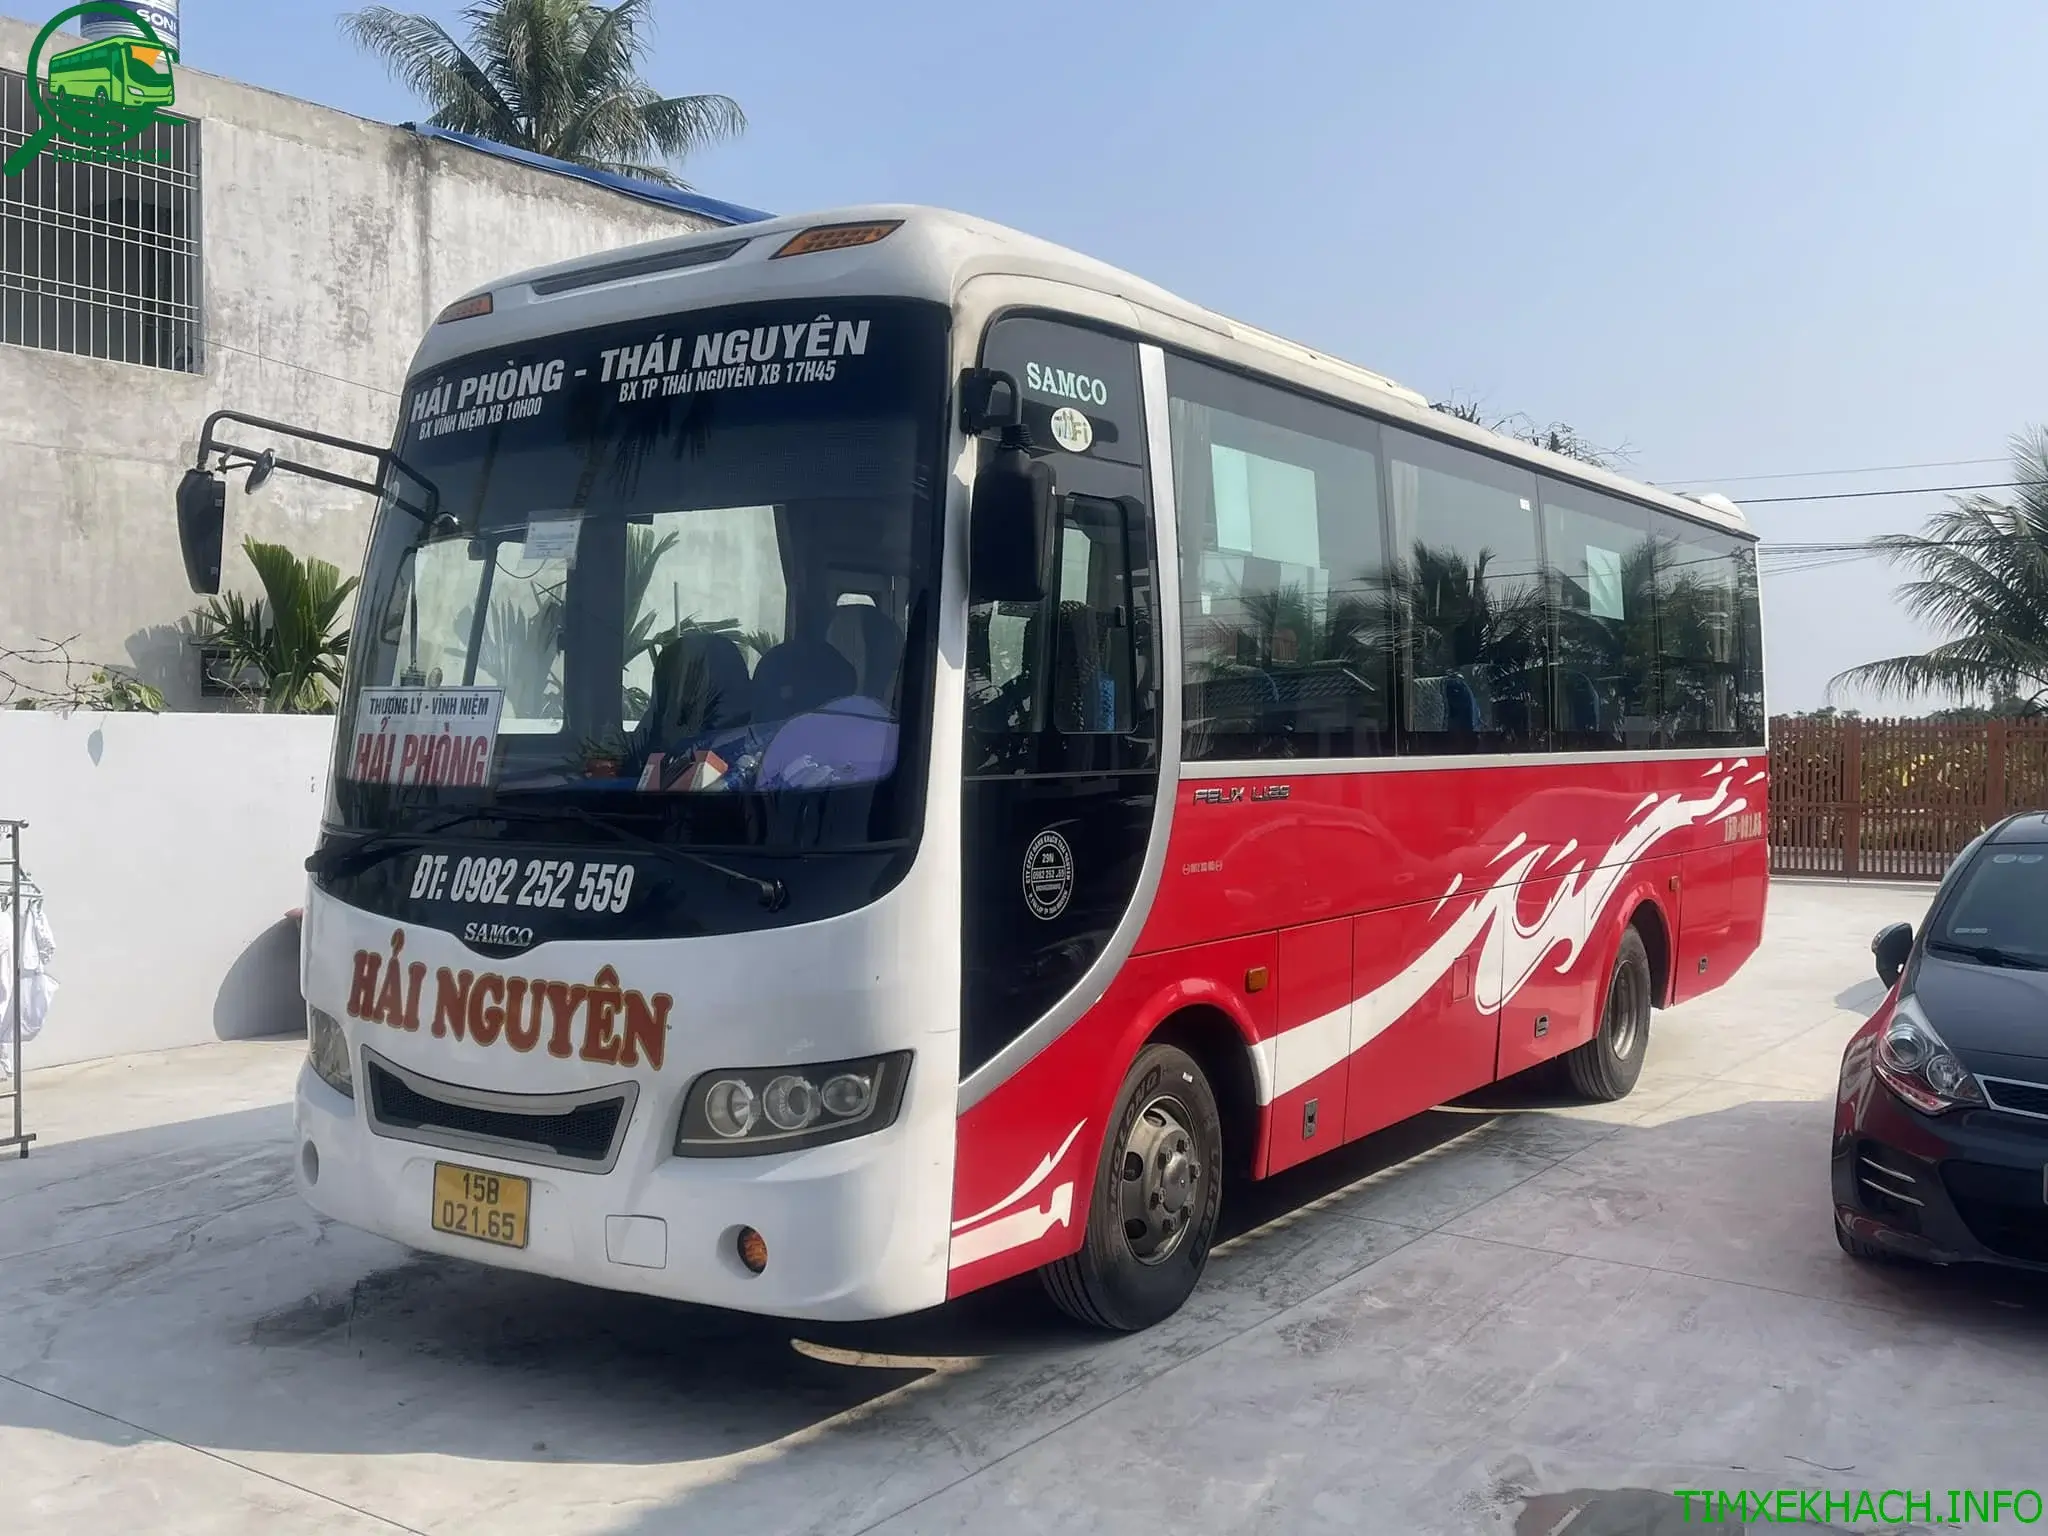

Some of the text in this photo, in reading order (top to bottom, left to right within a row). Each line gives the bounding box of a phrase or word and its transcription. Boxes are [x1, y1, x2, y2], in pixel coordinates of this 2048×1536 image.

[410, 376, 452, 423] HẢI
[456, 359, 565, 410] PHÒNG
[600, 334, 683, 383] THÁI
[691, 313, 871, 369] NGUYÊN
[618, 360, 837, 403] BX TP THÁI NGUYÊN XB 17H45
[1026, 361, 1107, 406] SAMCO
[418, 420, 431, 441] BX
[457, 404, 486, 432] NIỆM
[487, 403, 504, 425] XB
[506, 396, 543, 421] 10H00
[410, 693, 423, 715] LÝ
[459, 693, 490, 720] NIỆM
[353, 717, 489, 786] HẢI PHÒNG
[1193, 787, 1246, 804] FELIX
[409, 854, 635, 914] ĐT: 0982 252 559
[464, 922, 534, 947] SAMCO
[346, 927, 674, 1072] HẢI NGUYÊN
[463, 1173, 500, 1205] 15B
[443, 1200, 515, 1241] 021.65
